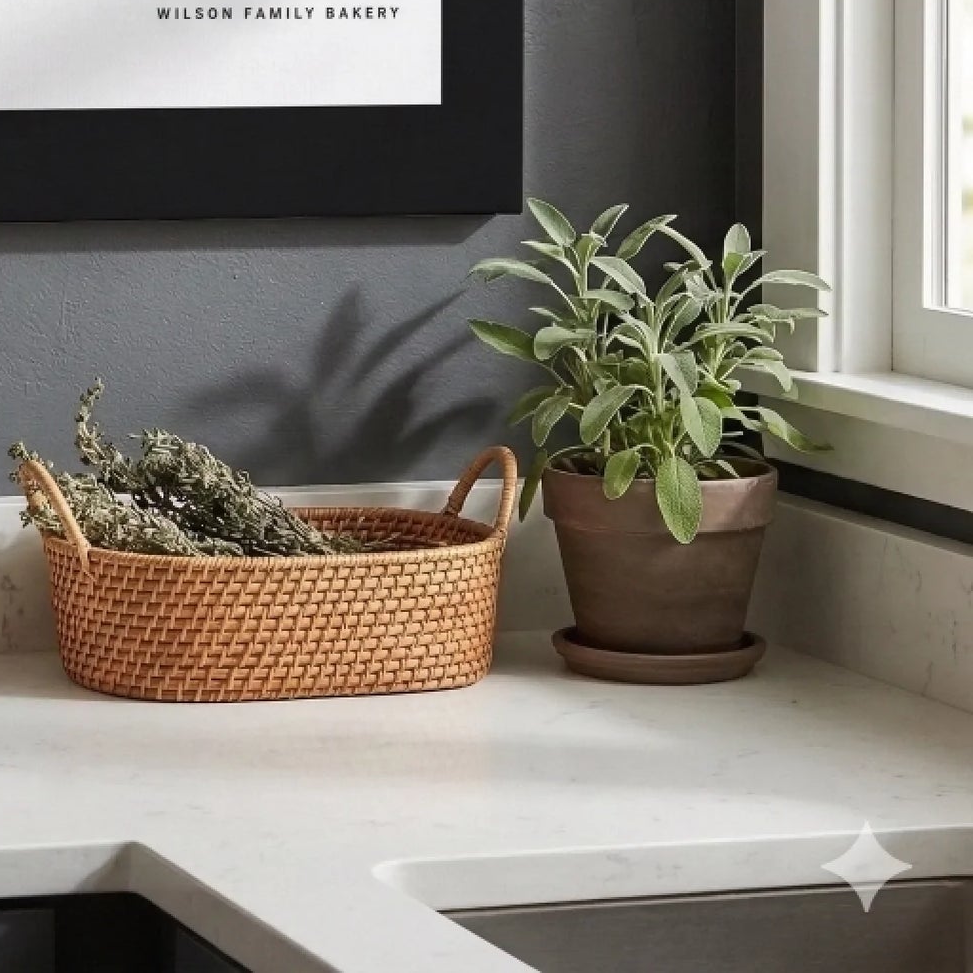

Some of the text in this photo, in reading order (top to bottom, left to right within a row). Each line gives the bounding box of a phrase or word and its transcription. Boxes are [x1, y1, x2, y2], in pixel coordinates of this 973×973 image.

[156, 6, 401, 20] WILSON FAMILY BAKERY
